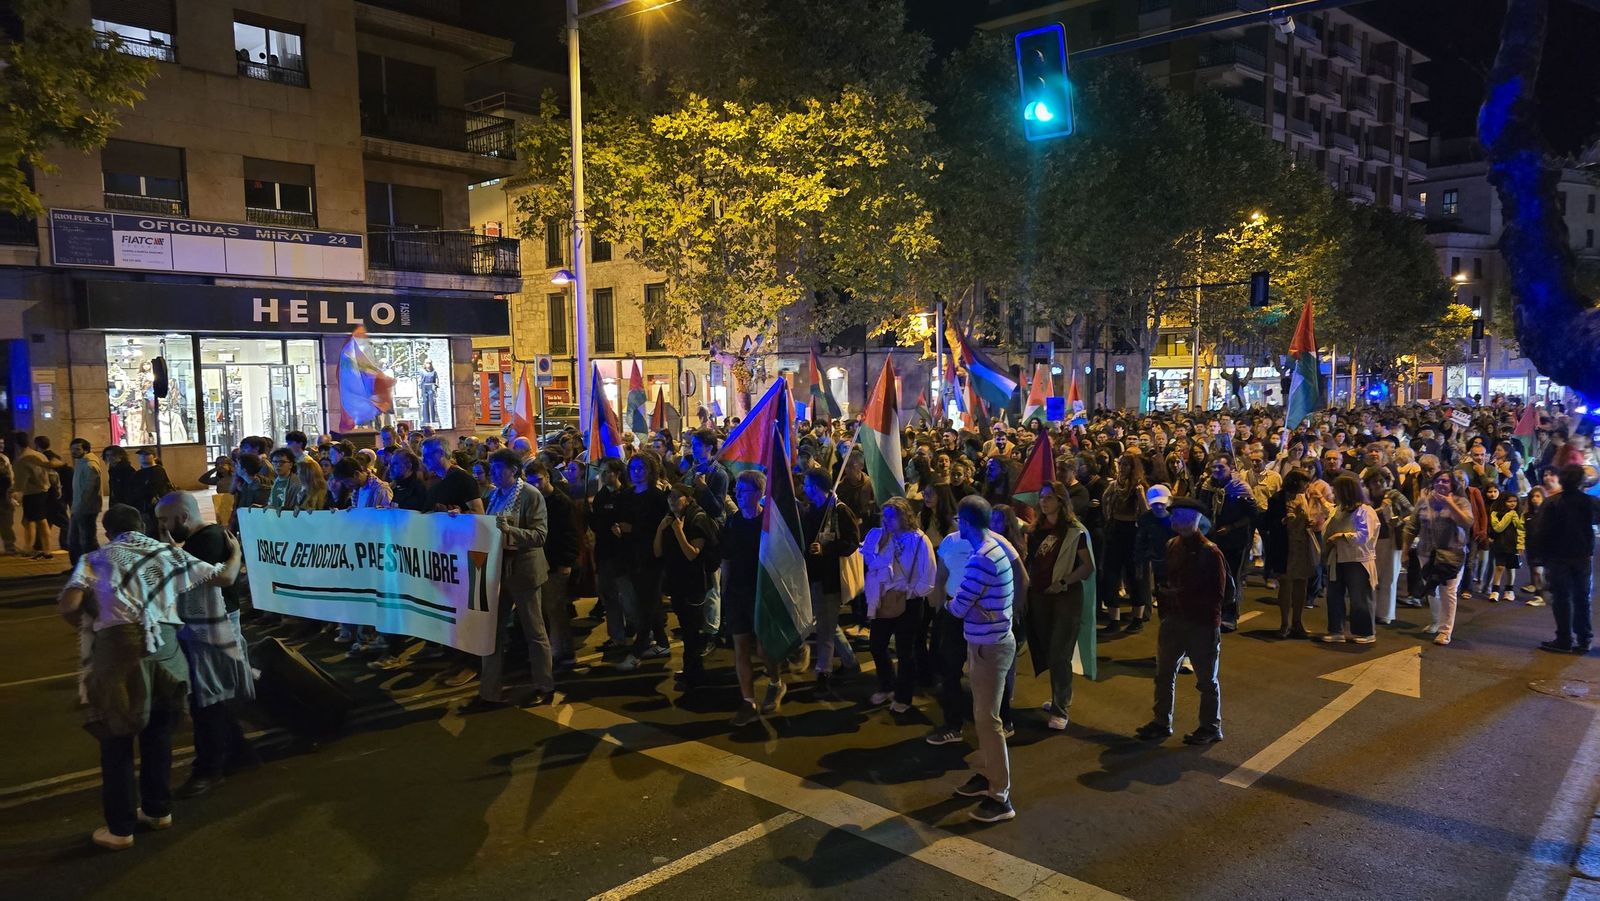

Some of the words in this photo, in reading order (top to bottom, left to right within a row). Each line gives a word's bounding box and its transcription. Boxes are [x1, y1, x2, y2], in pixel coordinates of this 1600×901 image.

[122, 235, 154, 245] FIATC
[139, 220, 240, 236] OFICINAS
[328, 235, 348, 245] 24
[253, 297, 396, 326] HELLO
[399, 302, 411, 326] FASHION
[257, 538, 289, 566] ISRAEL
[290, 542, 354, 571] GENOCIDA,
[422, 550, 460, 584] LIBRE
